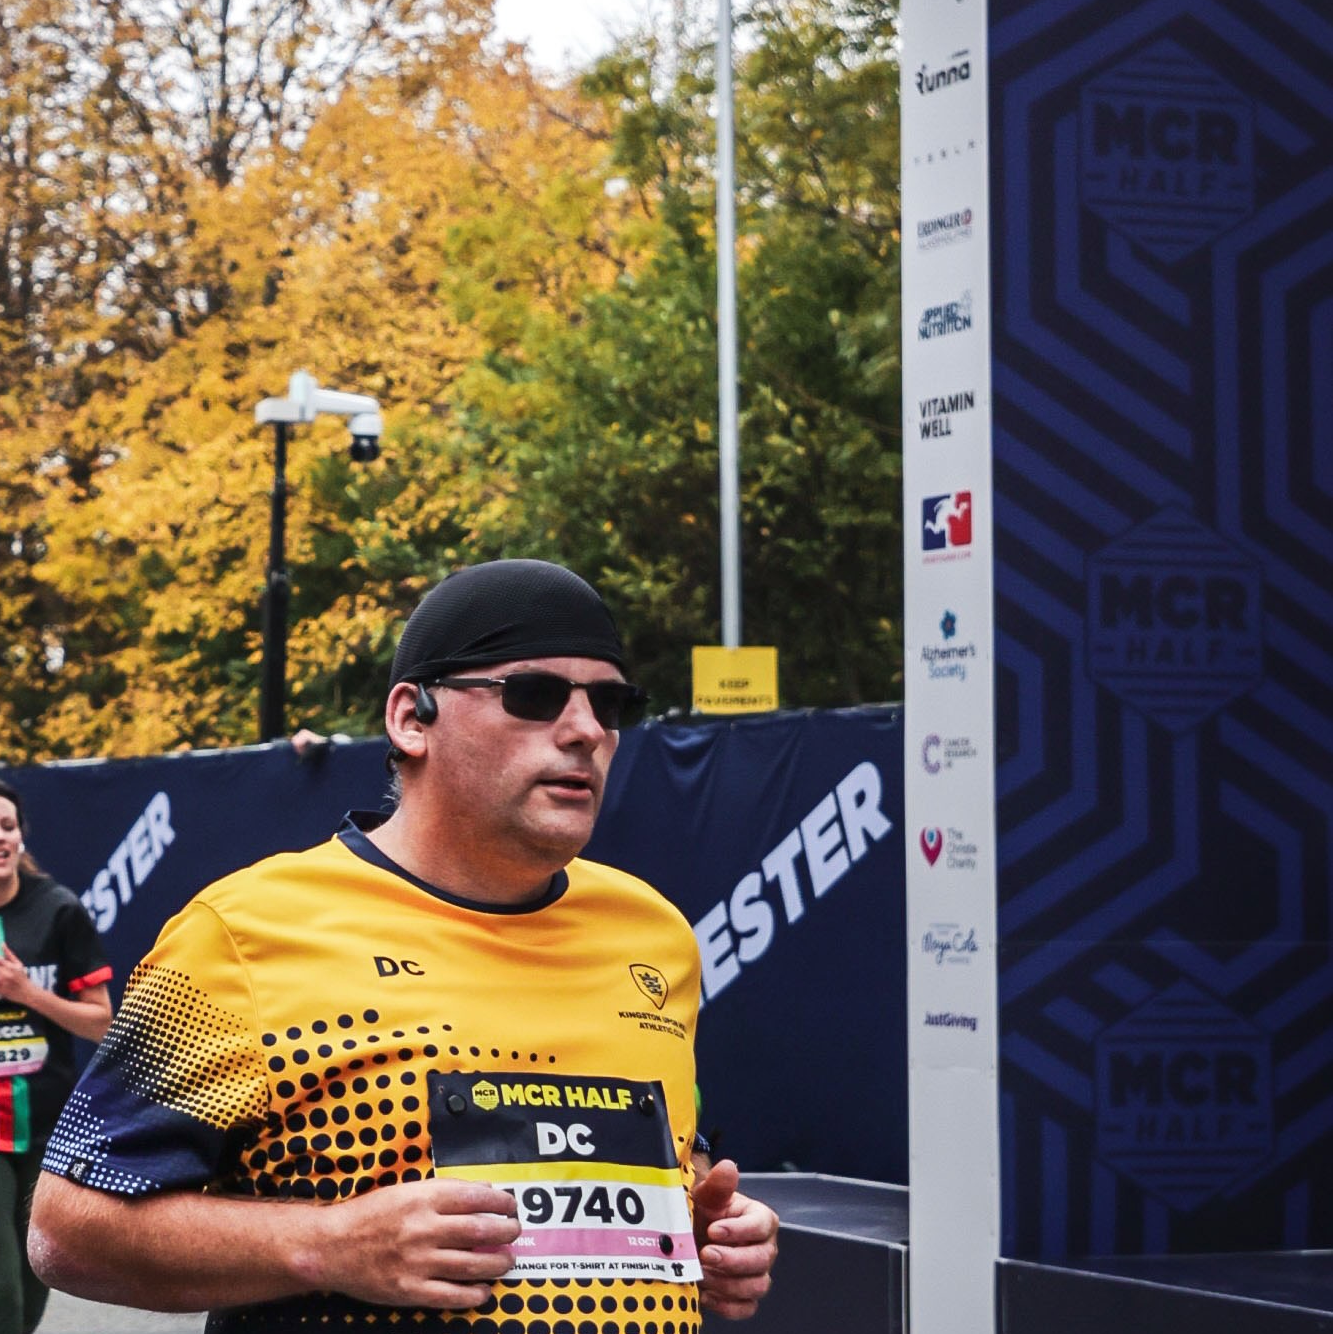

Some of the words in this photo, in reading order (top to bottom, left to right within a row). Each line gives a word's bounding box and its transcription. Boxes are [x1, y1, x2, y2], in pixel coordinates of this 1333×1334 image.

[1092, 104, 1240, 165] MCR
[920, 392, 974, 418] VITAMIN
[920, 418, 951, 439] WELL
[1099, 575, 1248, 632] MCR
[692, 761, 893, 1007] ESTER
[373, 956, 425, 977] DC
[618, 1011, 661, 1023] KINGSTON
[925, 1011, 977, 1032] JustGiving
[1109, 1051, 1259, 1107] MCR
[501, 1083, 562, 1107] MCR
[565, 1086, 633, 1110] HALF
[536, 1122, 595, 1156] DC
[628, 1236, 637, 1246] 12
[638, 1237, 655, 1247] OCT
[551, 1262, 569, 1270] FOR
[571, 1262, 605, 1270] T-SHIRT
[609, 1262, 618, 1270] AT
[622, 1262, 649, 1271] FINISH
